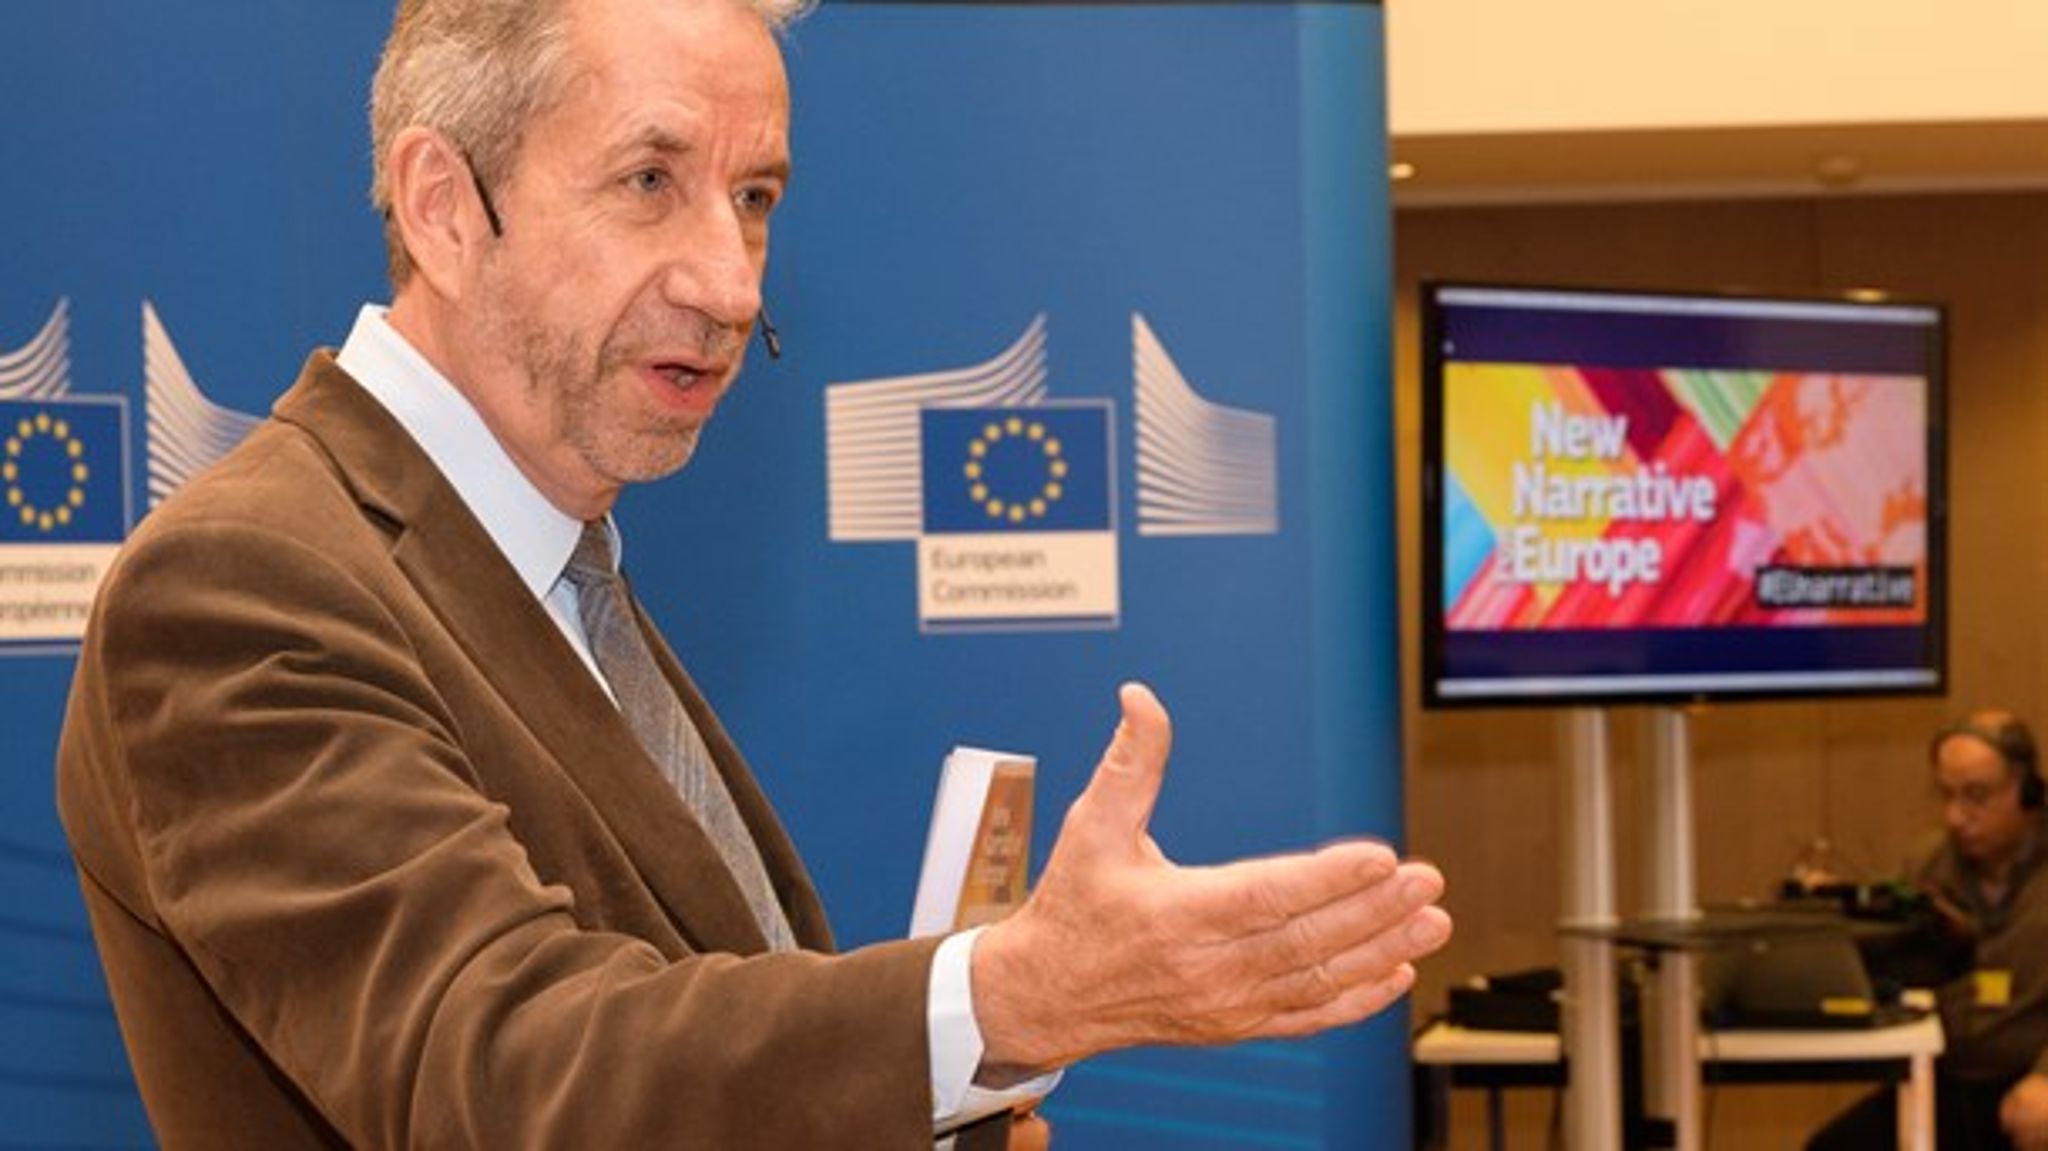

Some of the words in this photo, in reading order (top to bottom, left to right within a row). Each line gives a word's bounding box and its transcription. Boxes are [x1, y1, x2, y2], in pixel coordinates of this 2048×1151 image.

[1531, 398, 1628, 459] New
[1512, 461, 1718, 522] Narrative
[931, 547, 1047, 573] European
[931, 578, 1080, 602] Commission
[1513, 524, 1663, 597] Europe
